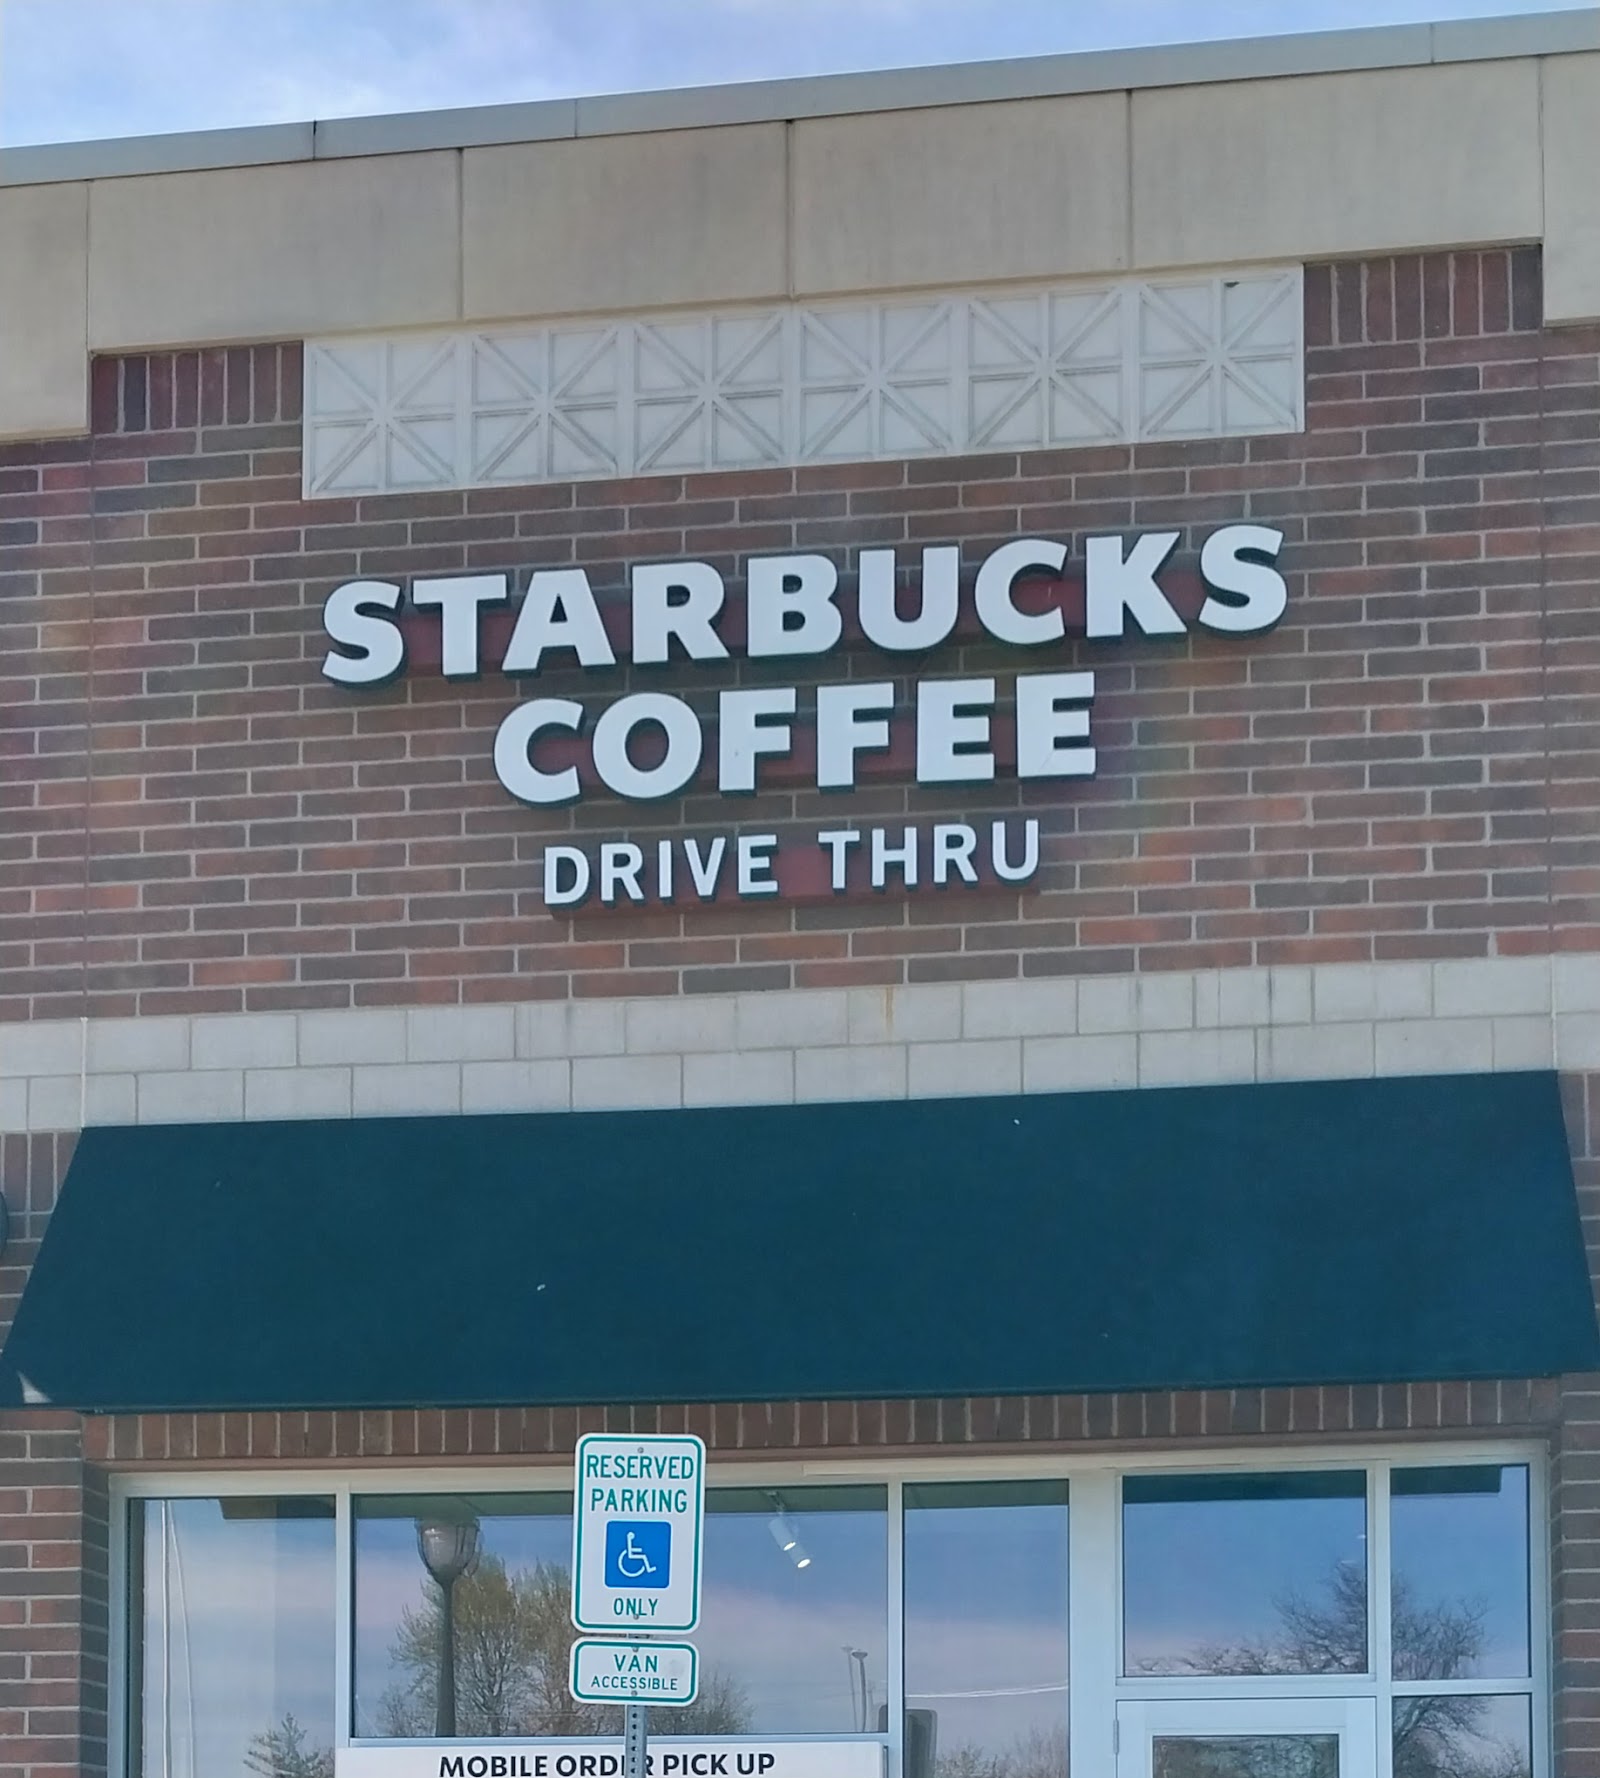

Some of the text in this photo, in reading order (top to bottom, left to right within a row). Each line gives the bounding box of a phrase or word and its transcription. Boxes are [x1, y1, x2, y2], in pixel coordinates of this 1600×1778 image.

[321, 524, 1288, 684] STARBUCKS
[493, 671, 1097, 803] COFFEE
[543, 819, 1041, 905] DRIVE THRU
[586, 1454, 694, 1480] RESERVED
[591, 1488, 688, 1513] PARKING
[613, 1597, 658, 1616] ONLY
[614, 1654, 658, 1673] VAN
[591, 1675, 678, 1691] ACCESSIBLE
[439, 1753, 775, 1778] MOBILE ORD PICK UP
